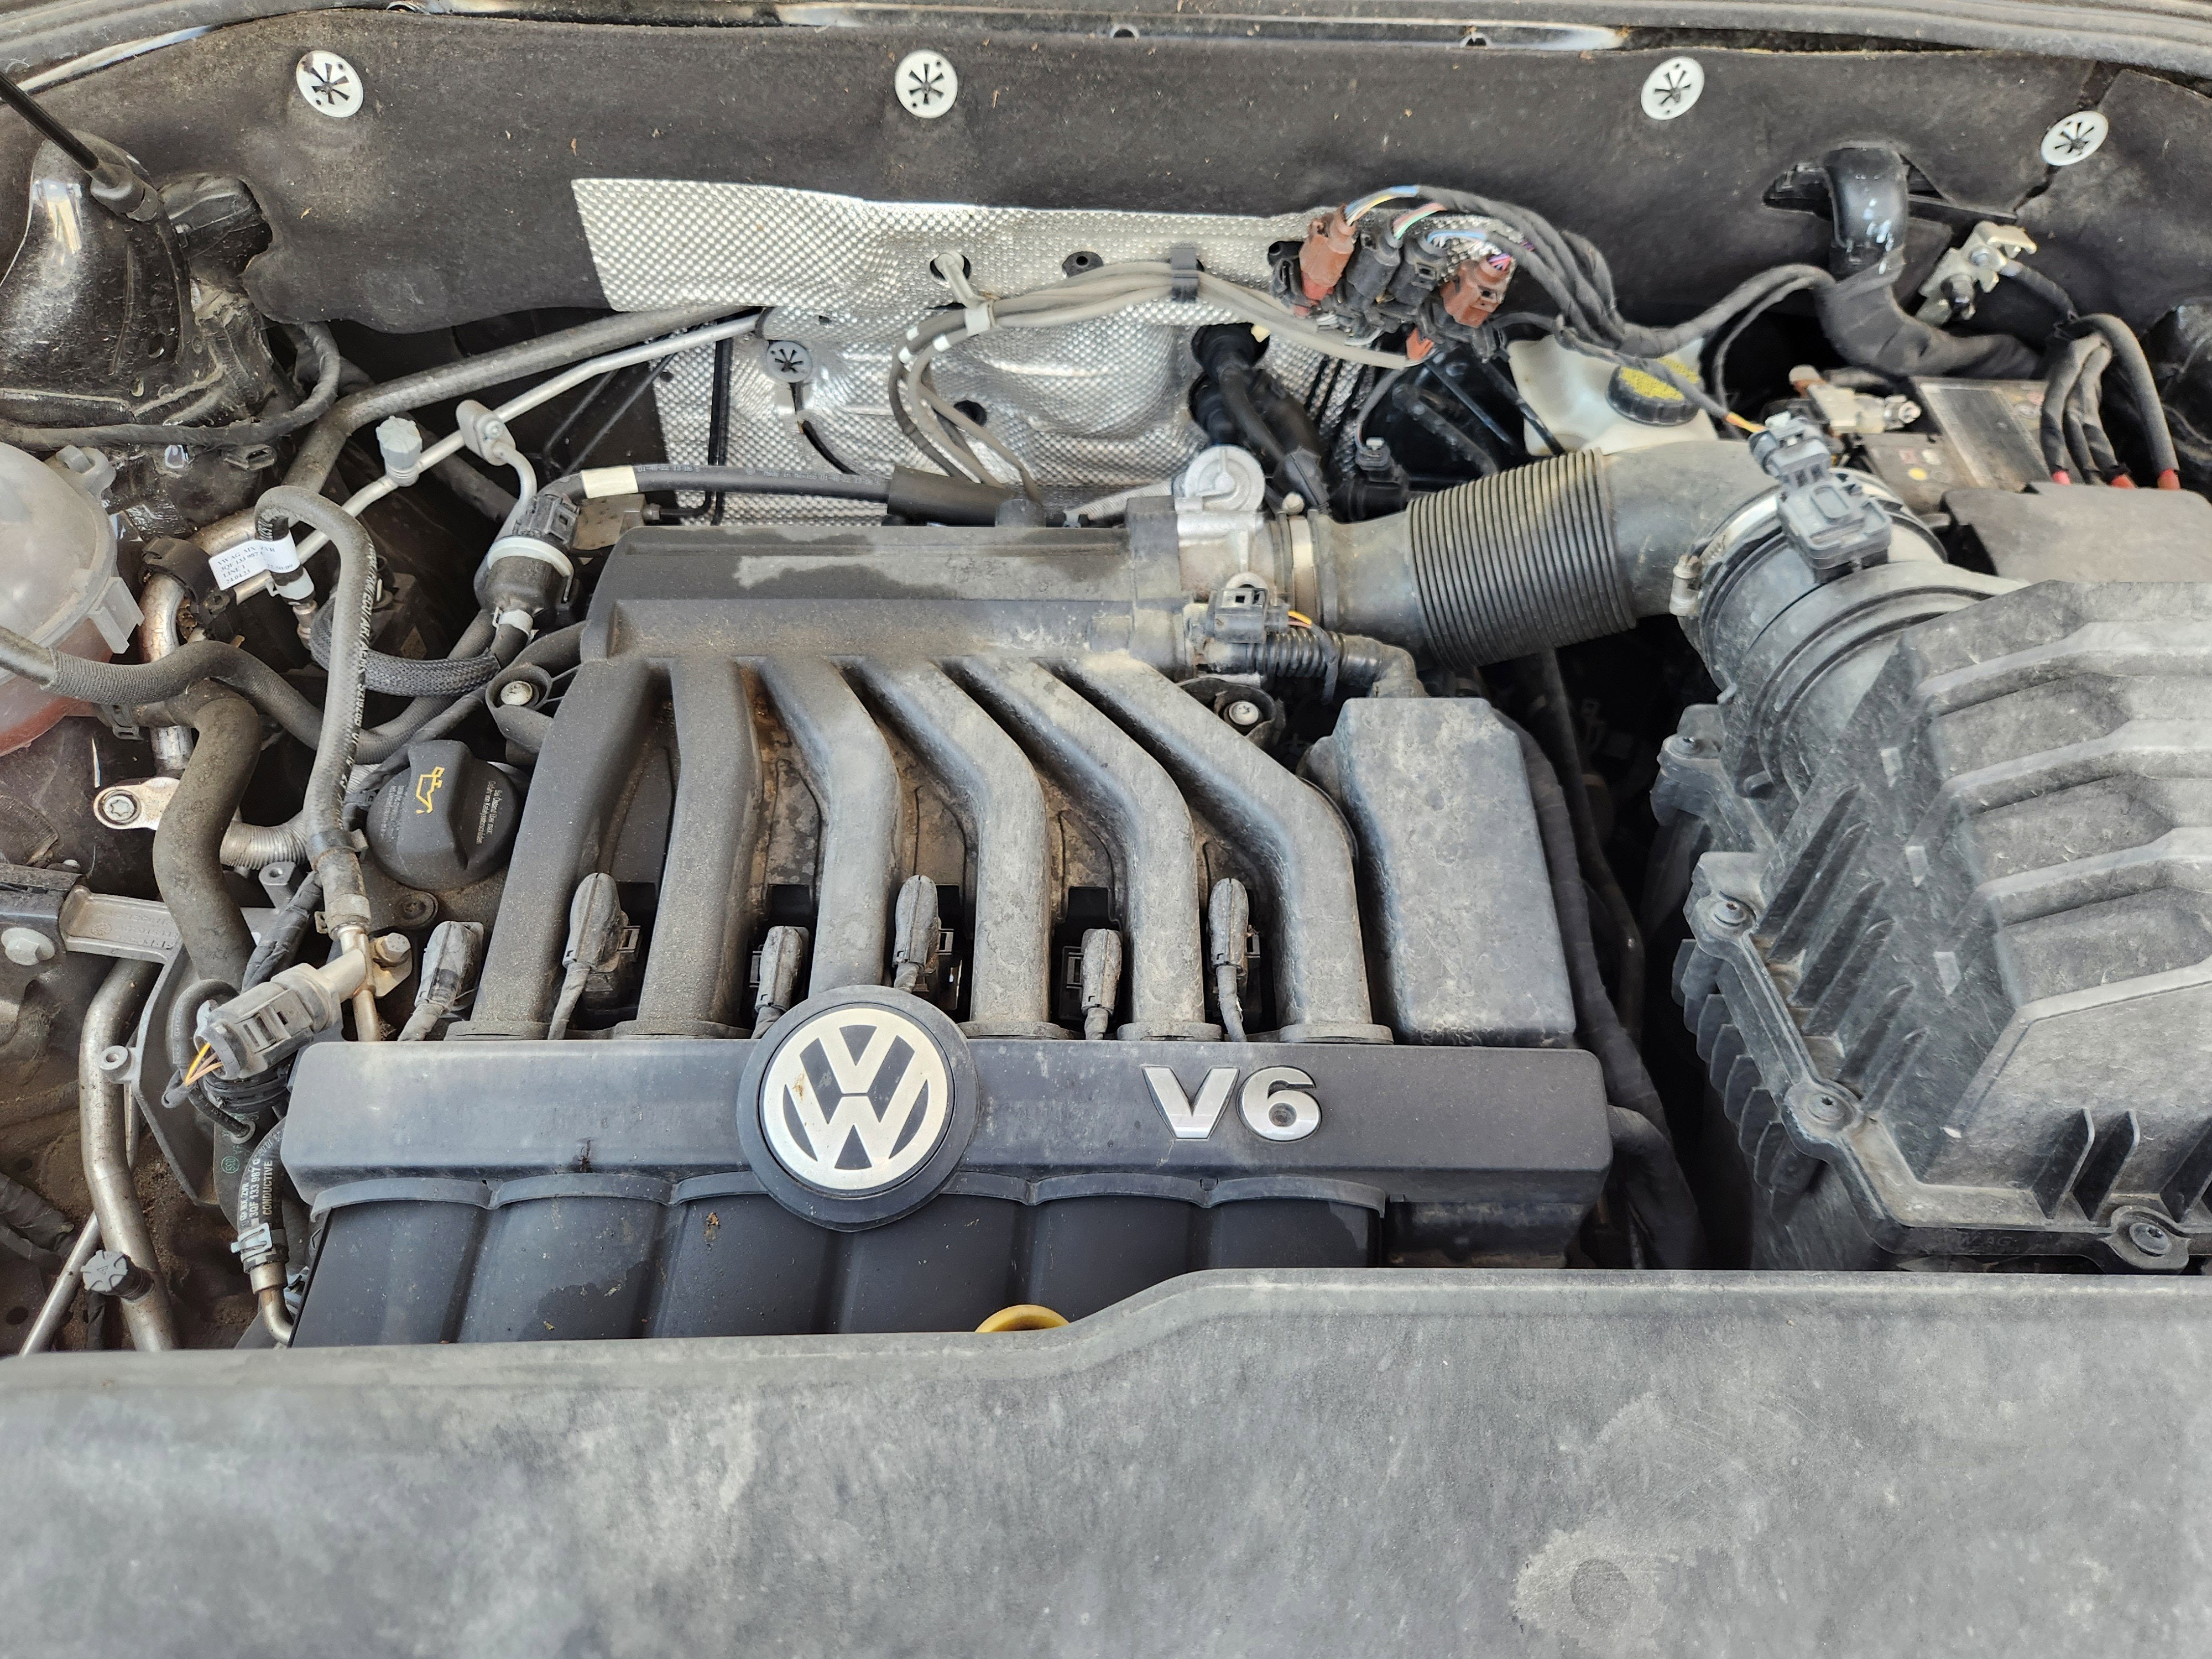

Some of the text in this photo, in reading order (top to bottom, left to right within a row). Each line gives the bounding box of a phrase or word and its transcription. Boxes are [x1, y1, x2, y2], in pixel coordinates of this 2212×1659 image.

[763, 1008, 948, 1190] VW
[1141, 1065, 1322, 1141] V6
[249, 1184, 259, 1199] 133
[251, 1167, 261, 1182] 987
[262, 1160, 273, 1215] CONDUCTIVE
[249, 1202, 259, 1217] 3QF
